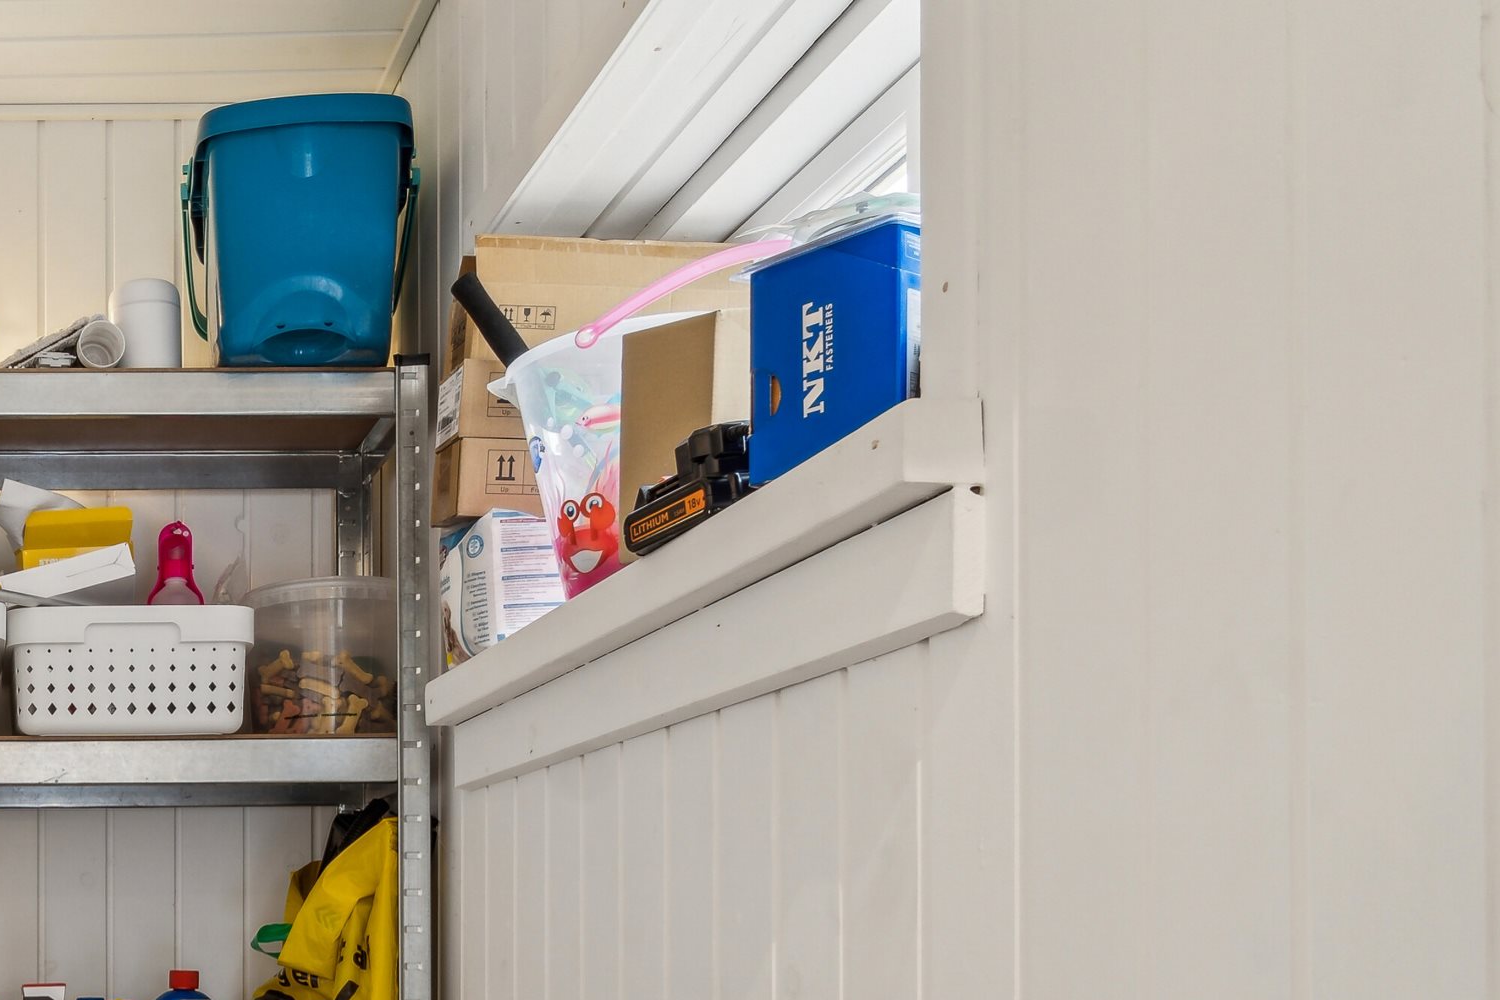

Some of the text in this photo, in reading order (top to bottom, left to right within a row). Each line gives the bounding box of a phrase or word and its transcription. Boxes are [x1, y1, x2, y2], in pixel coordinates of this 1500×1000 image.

[802, 302, 825, 418] NKT
[825, 303, 834, 371] FASTENERS
[633, 512, 669, 536] LITHIUM
